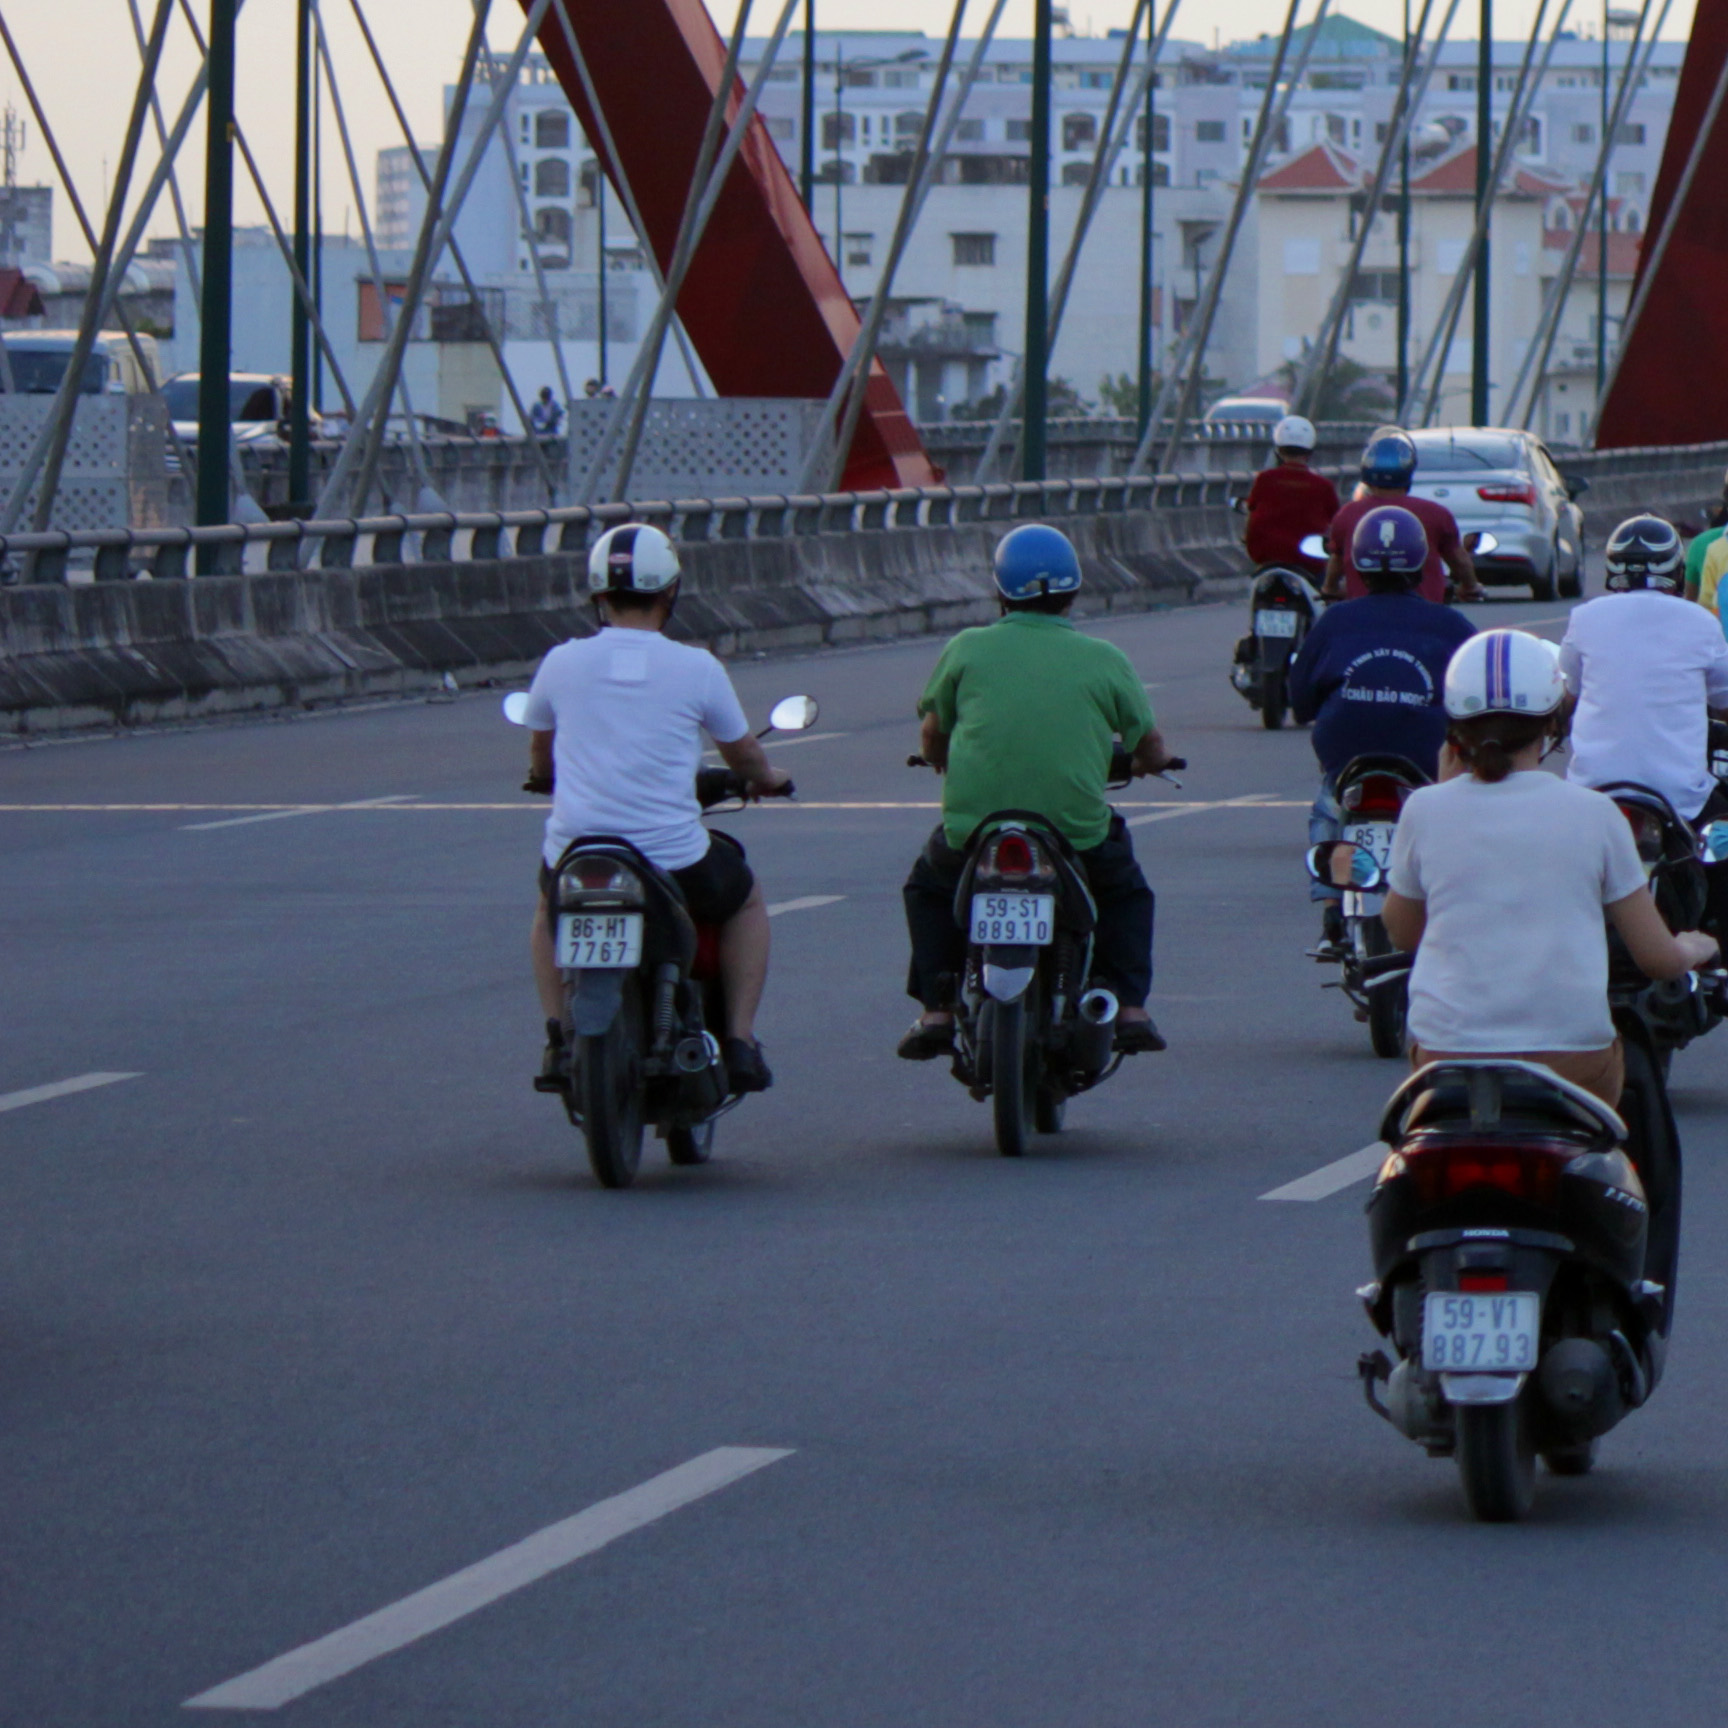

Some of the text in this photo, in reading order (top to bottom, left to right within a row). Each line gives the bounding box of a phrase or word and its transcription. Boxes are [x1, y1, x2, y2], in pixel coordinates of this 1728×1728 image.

[986, 898, 1039, 918] 59-S1
[571, 918, 627, 939] 86-H1
[978, 920, 1047, 940] 889.10
[570, 942, 628, 964] 7767
[1462, 1229, 1510, 1238] HONDA
[1443, 1298, 1519, 1330] 59-V1
[1432, 1333, 1530, 1365] 887.93
